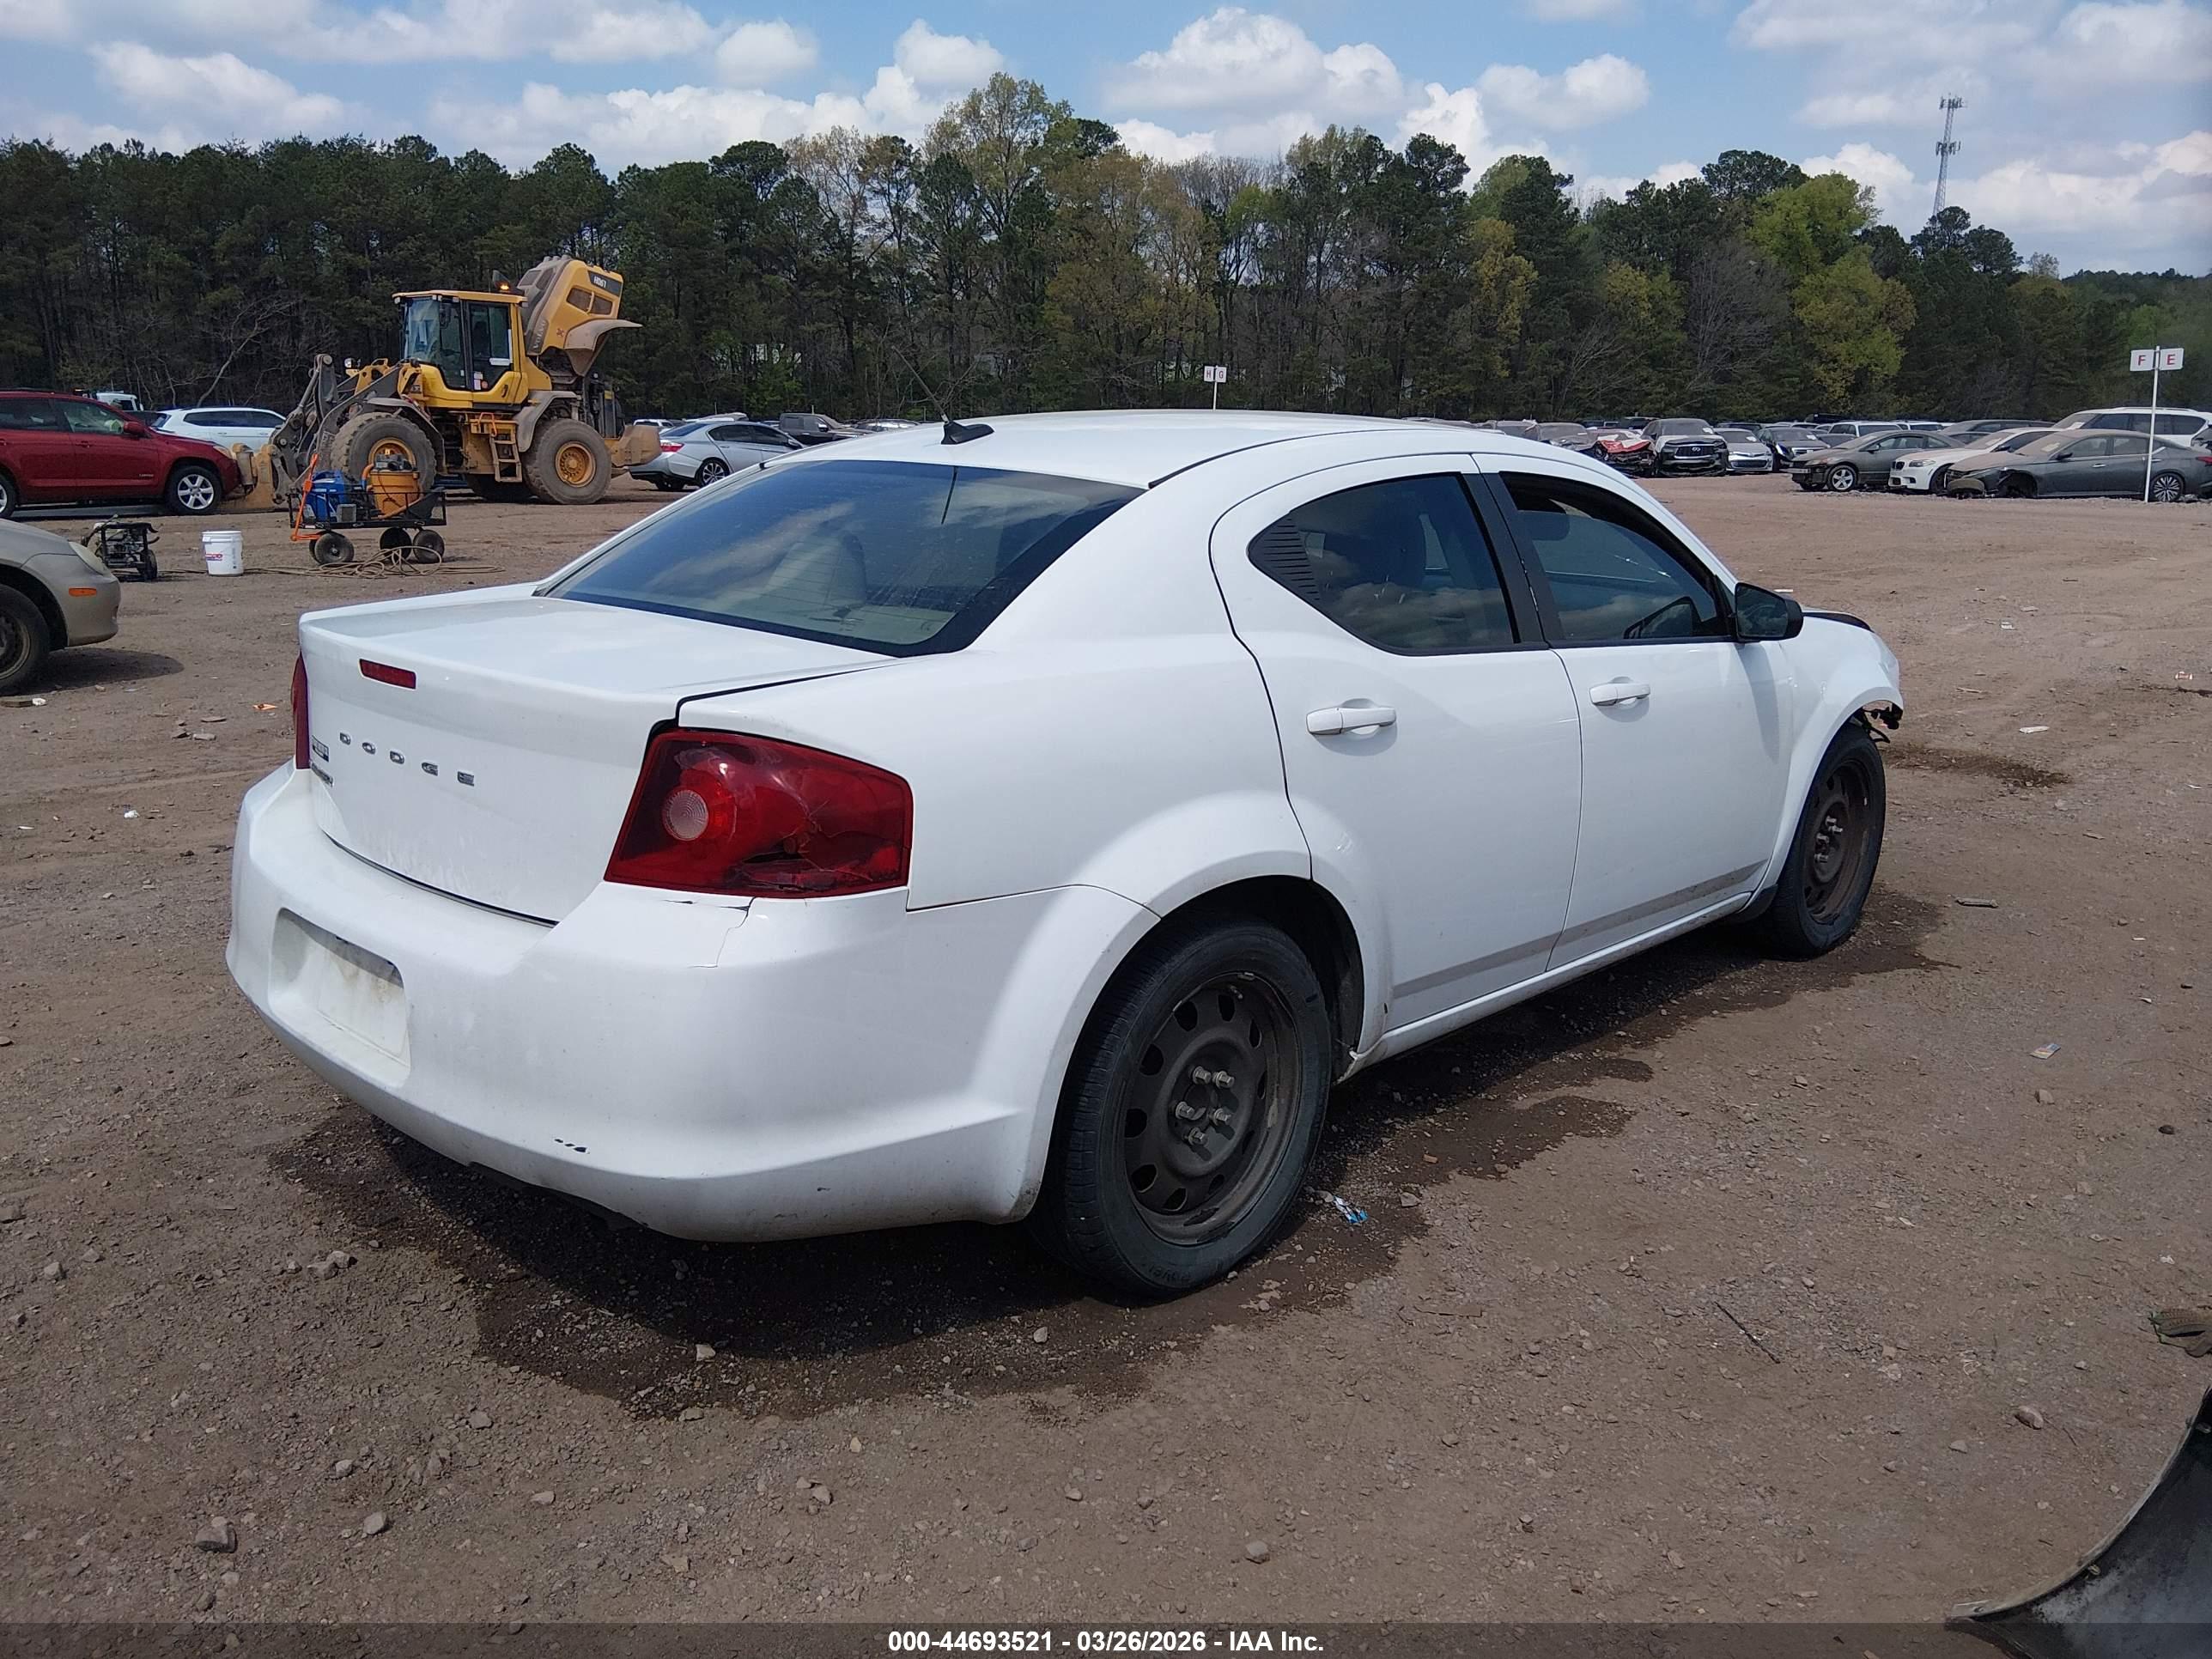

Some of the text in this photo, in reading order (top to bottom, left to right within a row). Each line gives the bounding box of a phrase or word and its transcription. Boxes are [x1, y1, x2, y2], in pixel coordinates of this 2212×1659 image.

[2137, 355, 2147, 366] F
[2166, 354, 2176, 366] E
[339, 732, 475, 787] DODGE
